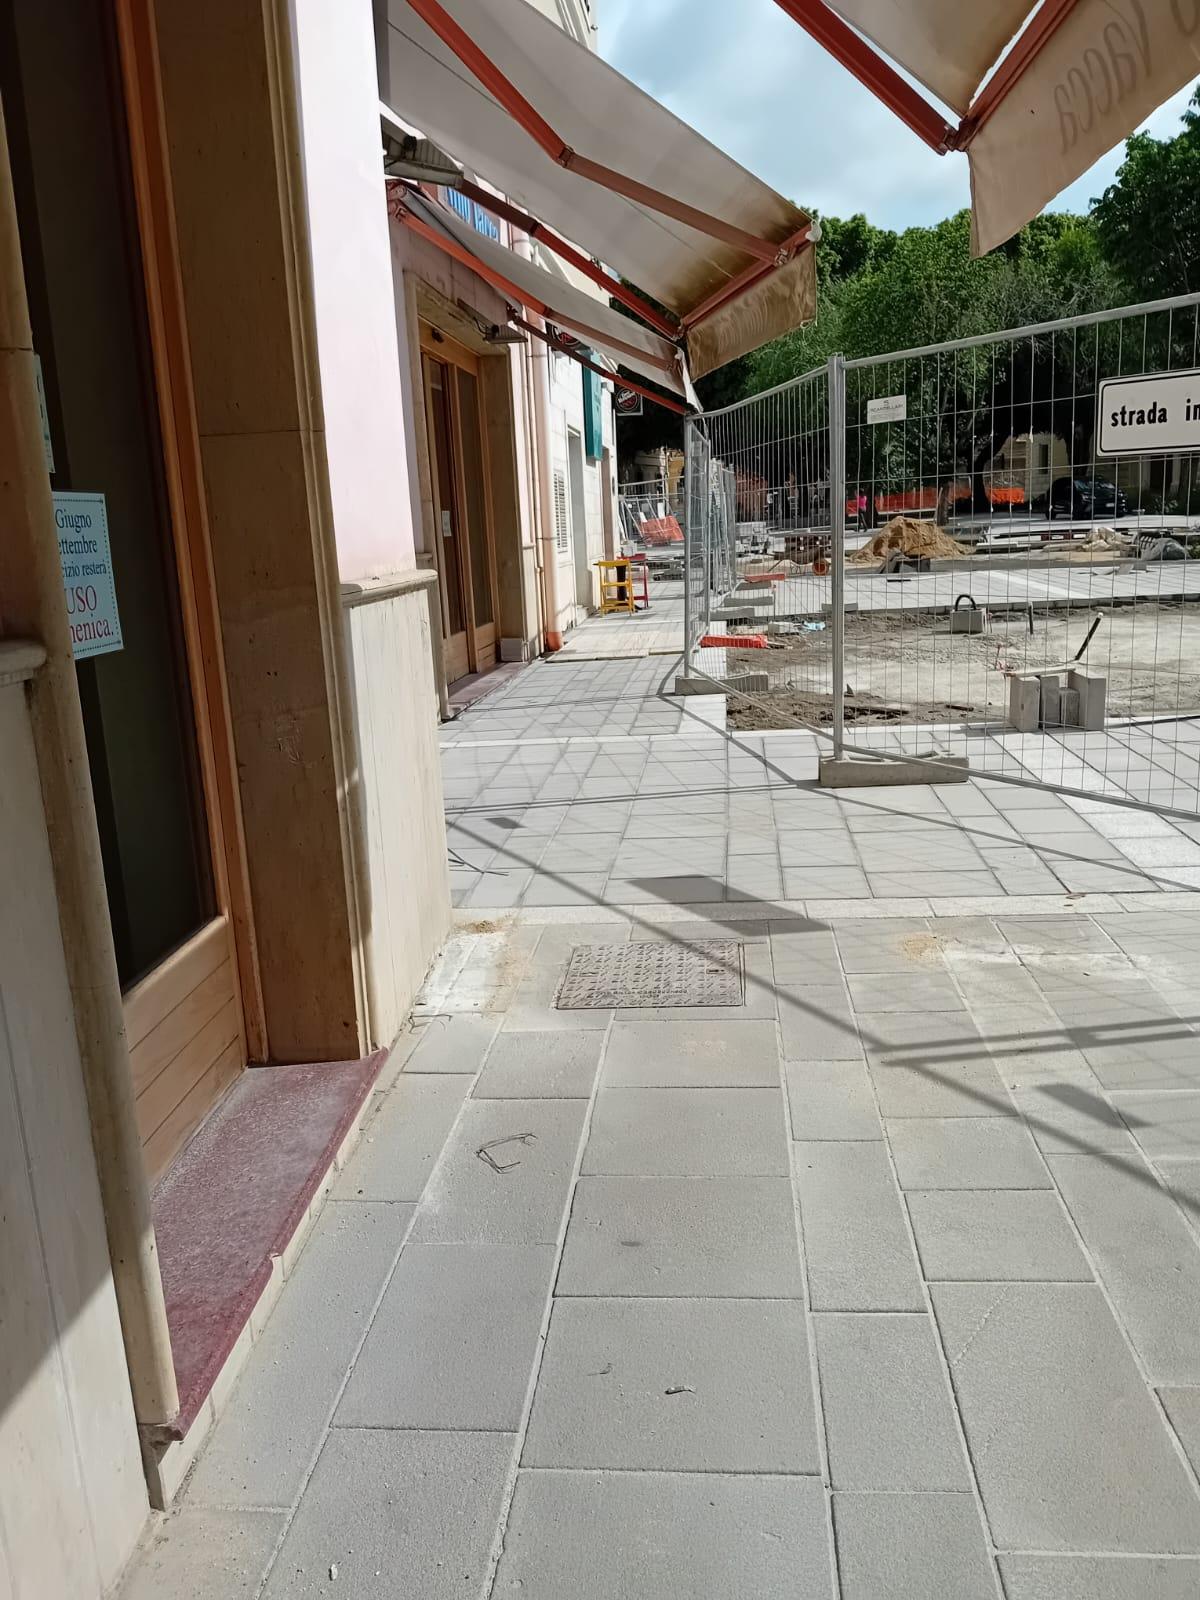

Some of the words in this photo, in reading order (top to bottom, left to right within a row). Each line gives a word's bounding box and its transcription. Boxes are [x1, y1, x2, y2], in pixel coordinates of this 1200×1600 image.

[1111, 401, 1168, 427] strada
[55, 508, 92, 533] Giugno
[58, 535, 98, 555] ttembre
[62, 561, 81, 577] izio
[64, 585, 97, 615] USO
